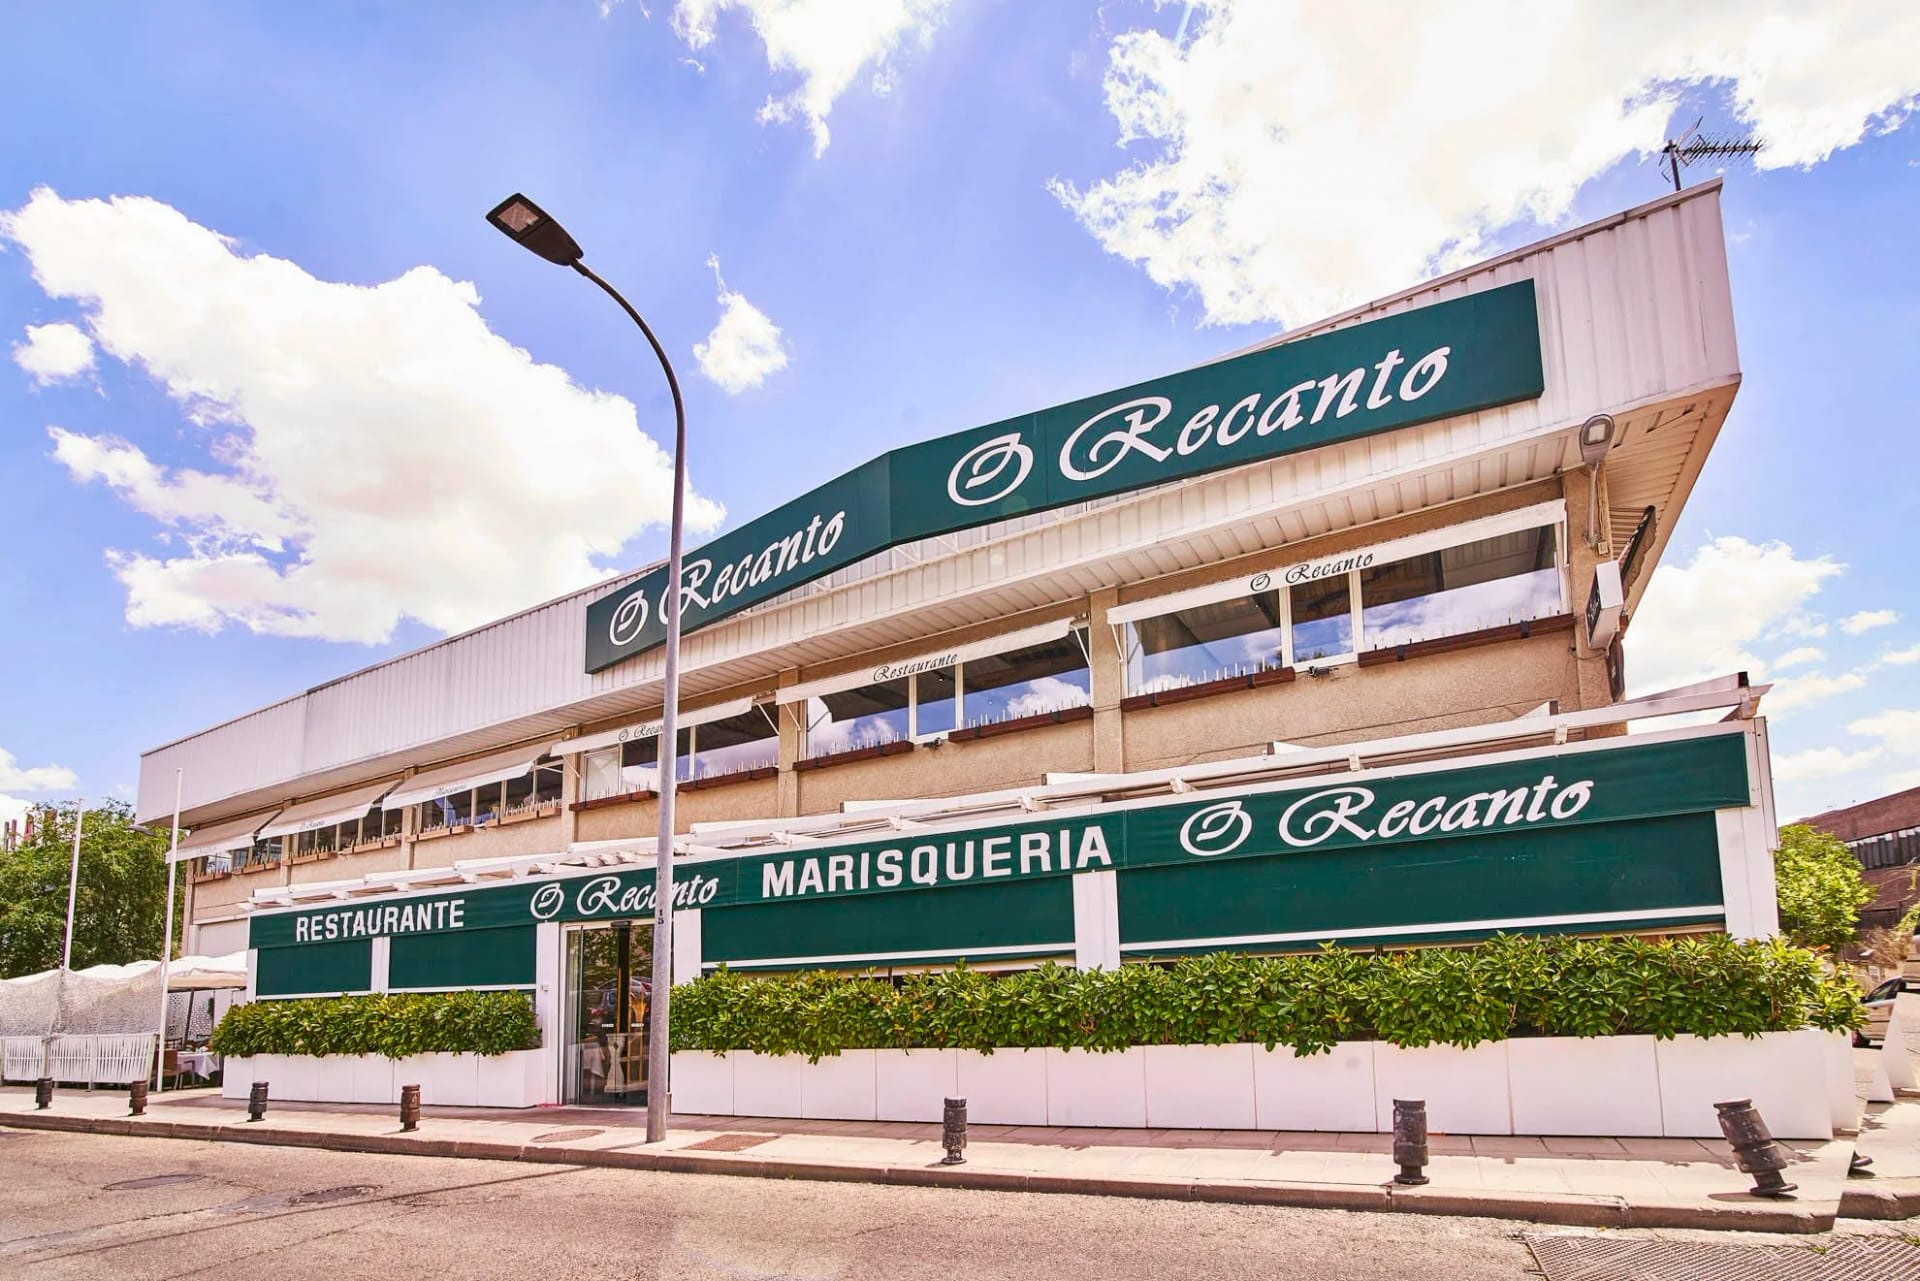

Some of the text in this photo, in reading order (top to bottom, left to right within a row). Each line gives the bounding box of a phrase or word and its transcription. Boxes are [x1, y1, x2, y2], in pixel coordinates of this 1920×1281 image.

[1058, 346, 1450, 482] Recanto
[658, 510, 846, 625] Recanto
[1285, 552, 1374, 584] Recanto
[873, 653, 958, 682] Restaurante
[1279, 775, 1594, 847] Recanto
[762, 825, 1112, 898] MARISQUERIA
[295, 899, 465, 943] RESTAURANTE
